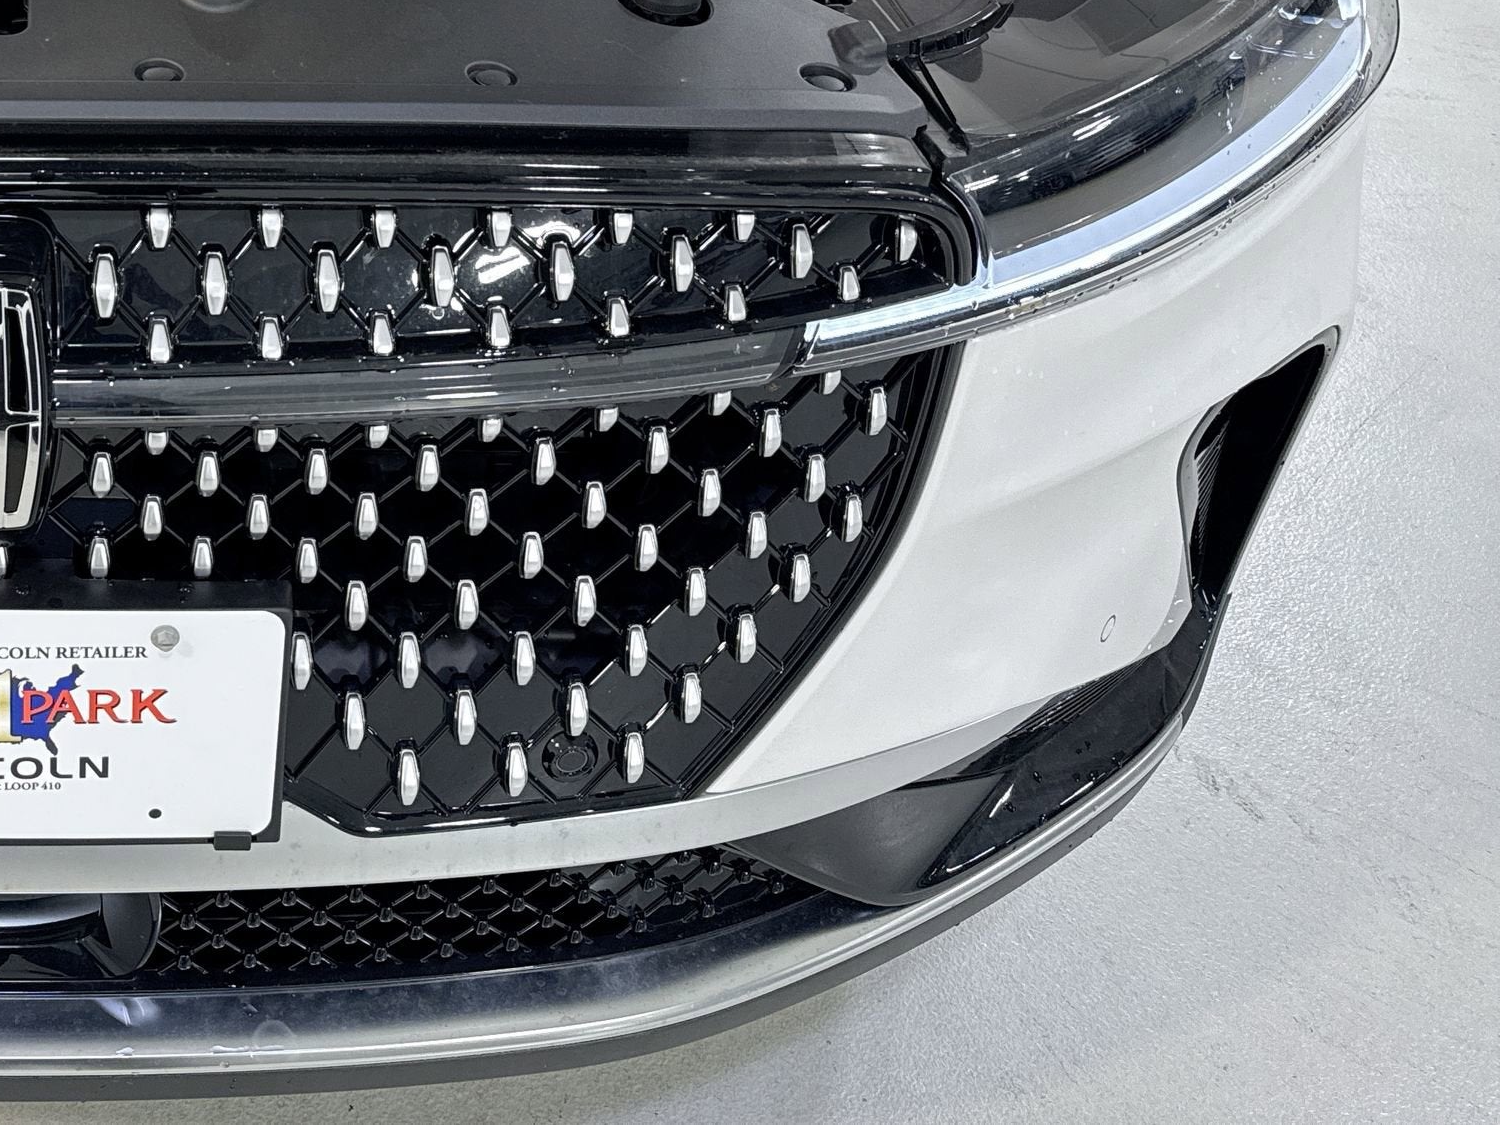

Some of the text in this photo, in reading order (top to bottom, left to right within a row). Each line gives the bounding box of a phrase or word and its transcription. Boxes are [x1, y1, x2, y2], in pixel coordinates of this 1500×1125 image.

[55, 646, 148, 659] RETAILER
[21, 688, 177, 725] PARK
[4, 782, 40, 791] LOOP
[40, 781, 62, 791] 410
